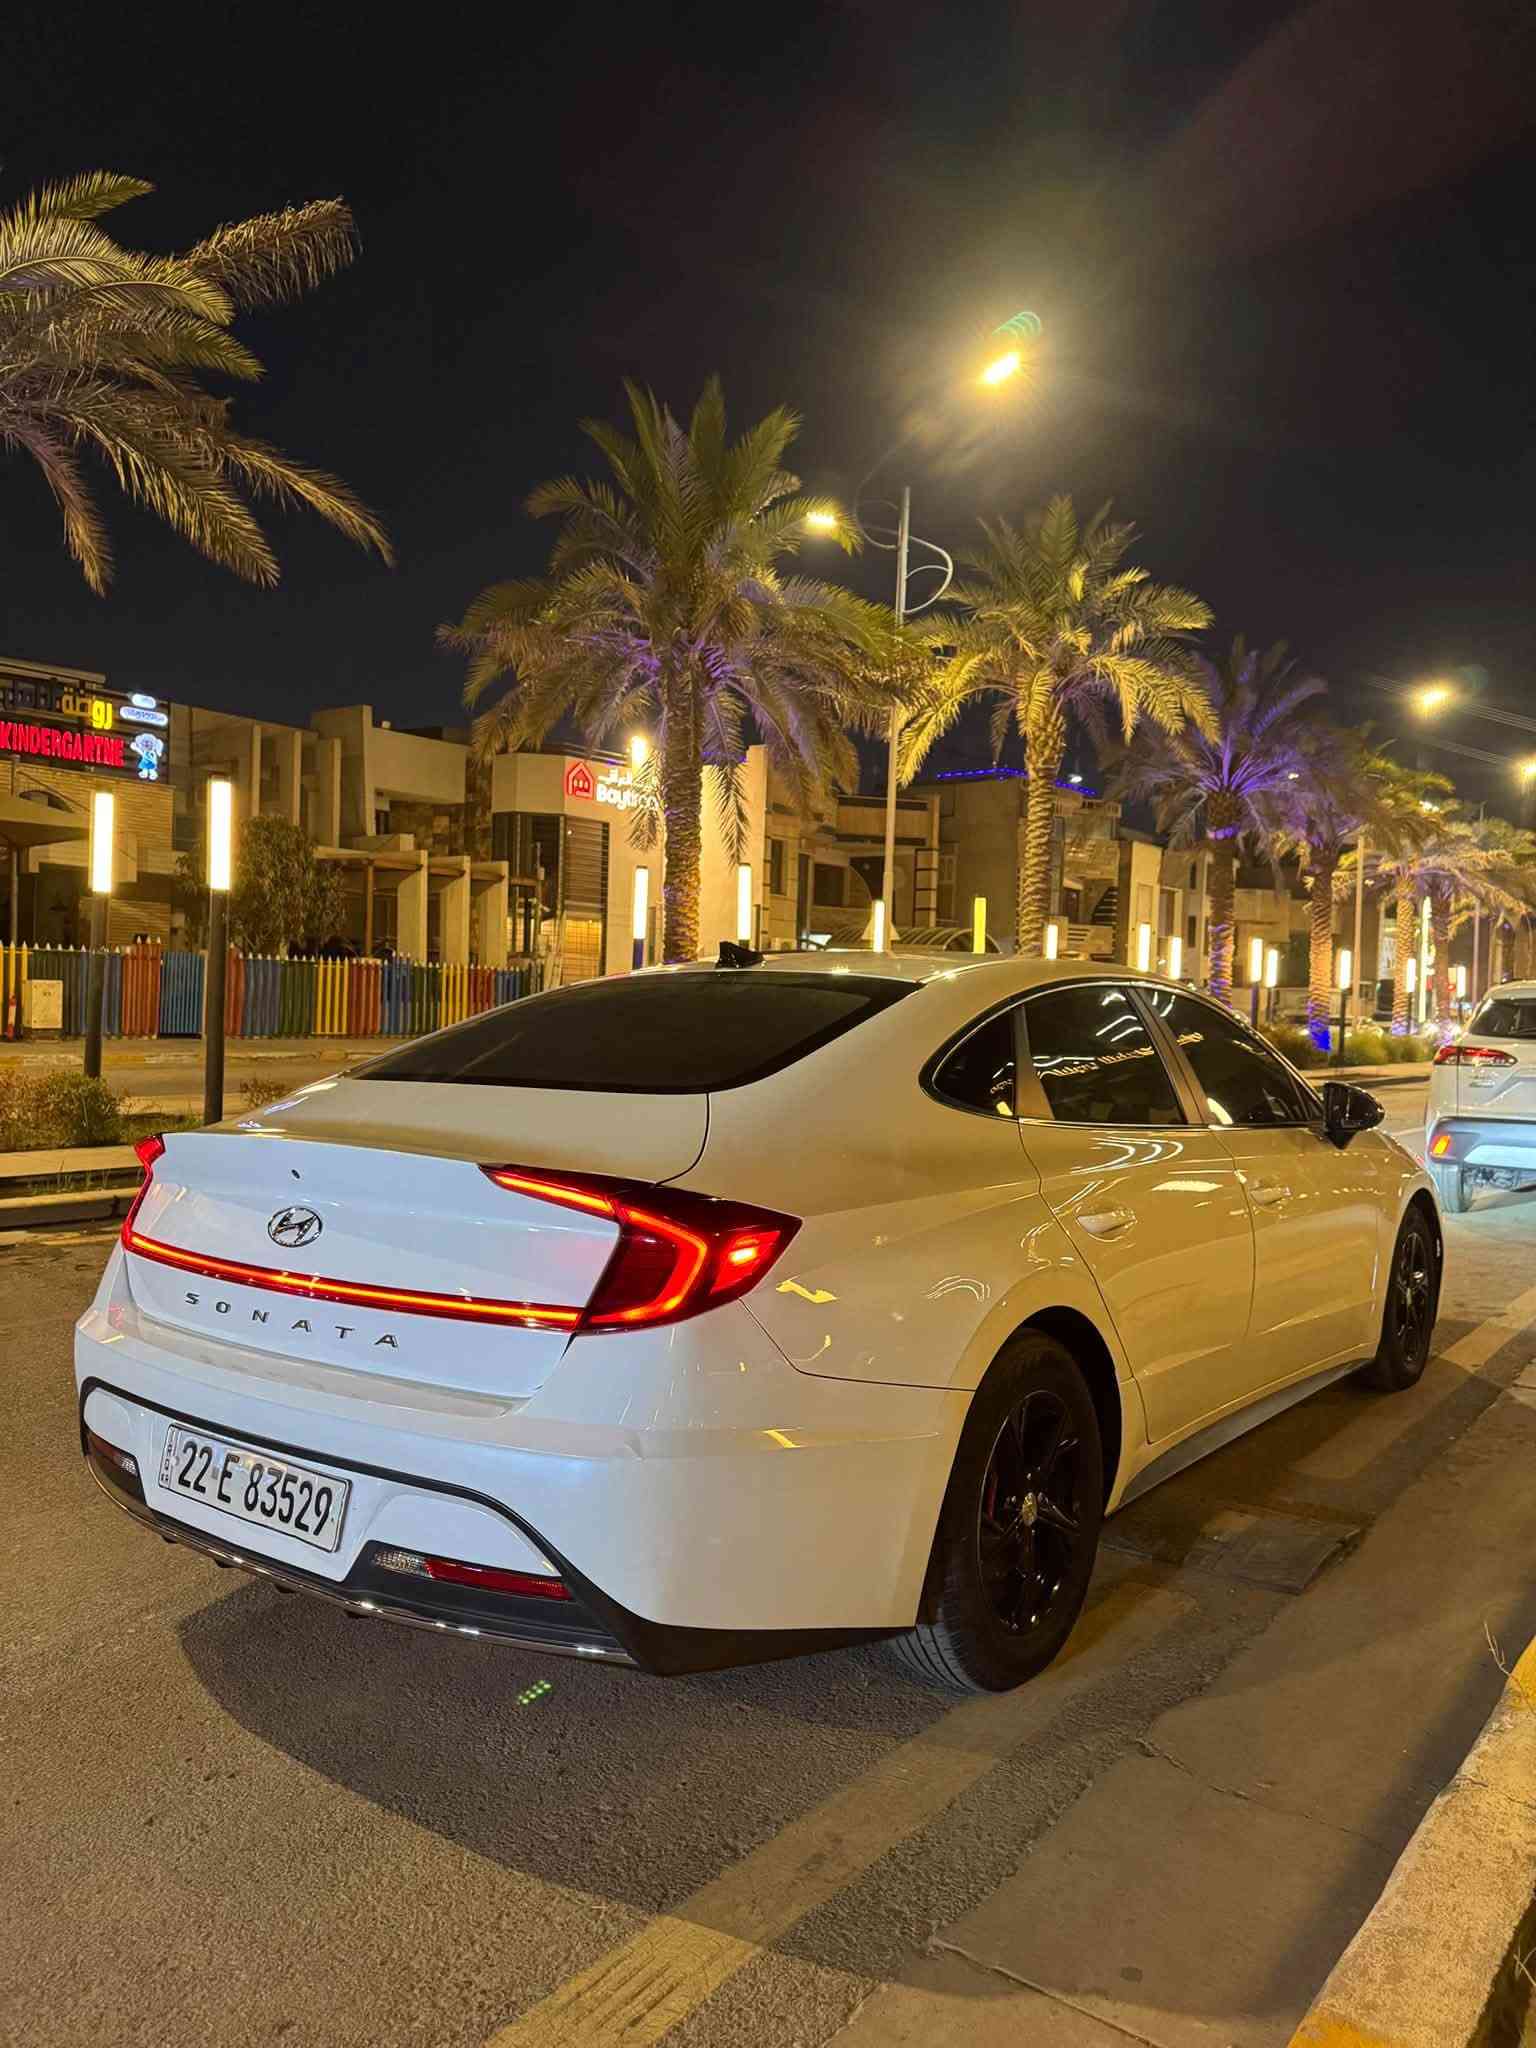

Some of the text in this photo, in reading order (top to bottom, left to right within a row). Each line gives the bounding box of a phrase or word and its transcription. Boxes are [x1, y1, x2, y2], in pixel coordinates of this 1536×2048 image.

[184, 1292, 399, 1349] SONATA
[178, 1440, 333, 1537] 22 E 83529
